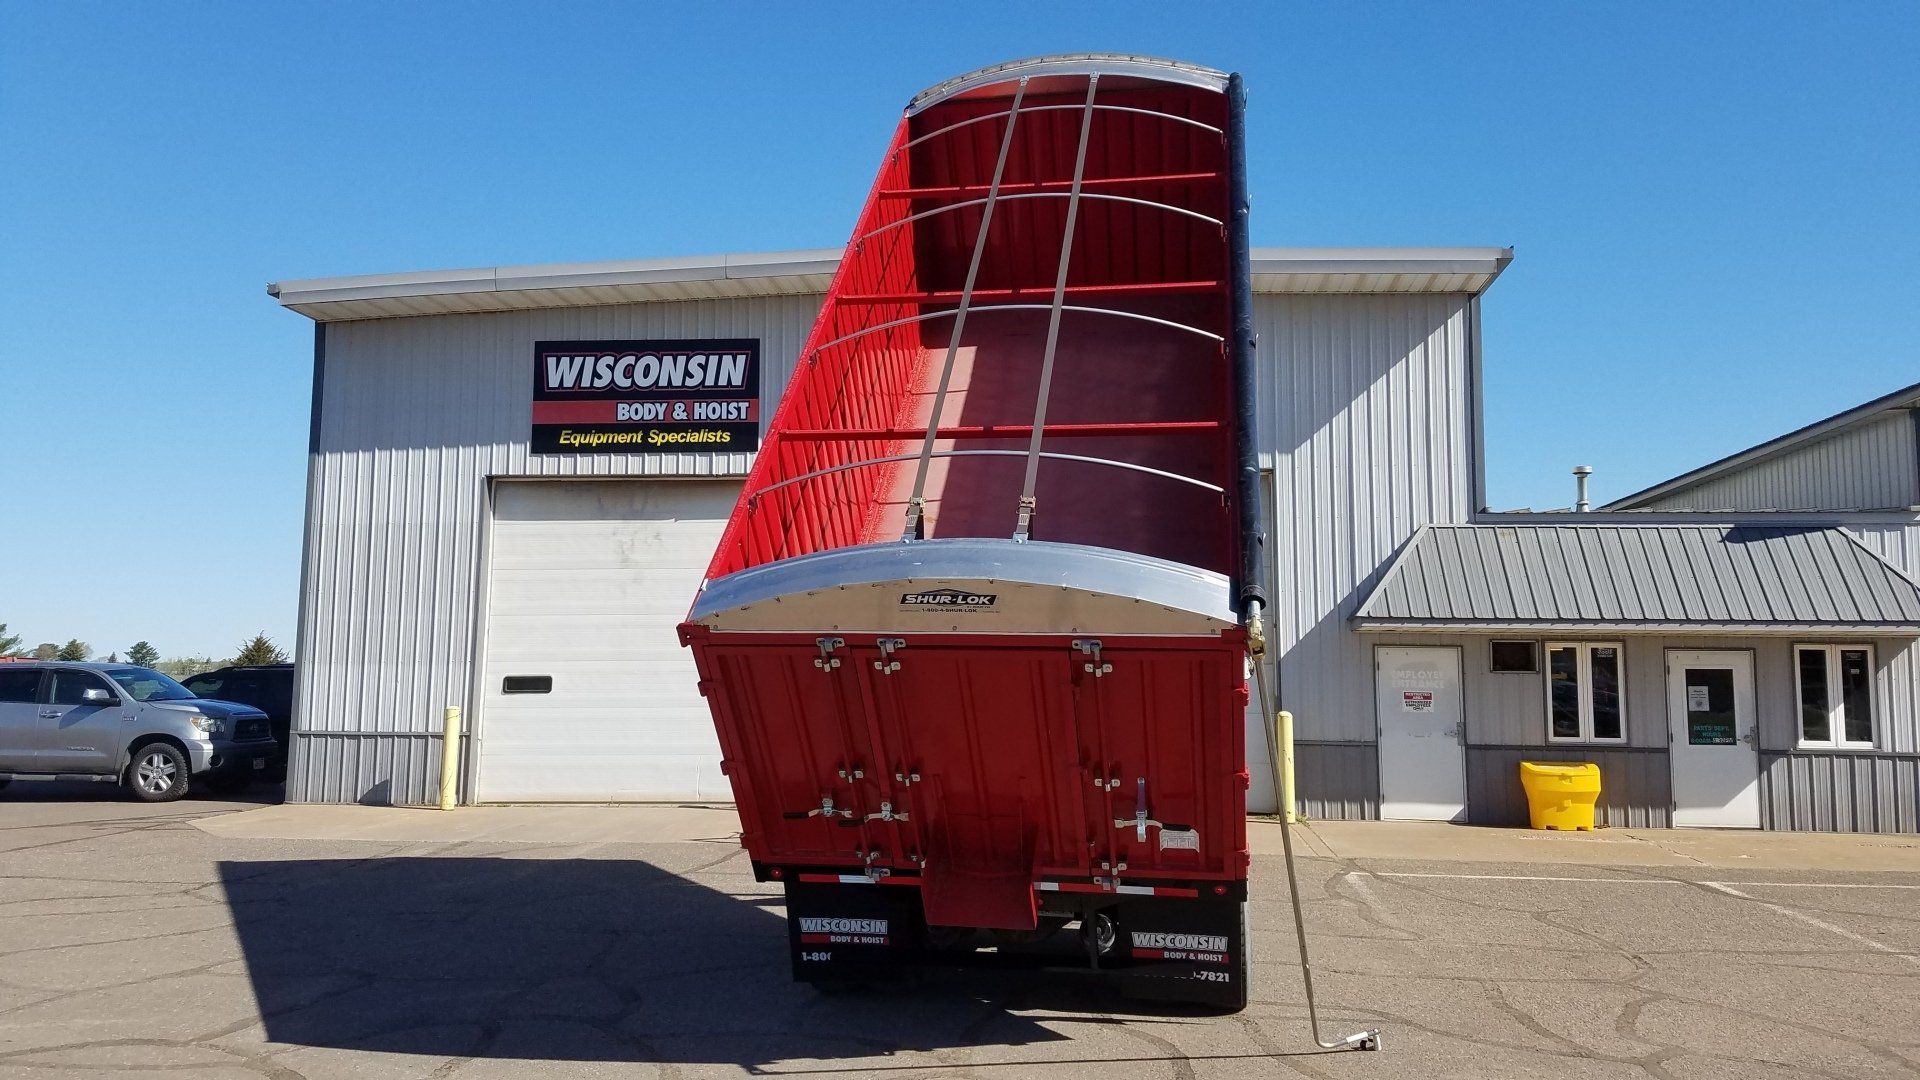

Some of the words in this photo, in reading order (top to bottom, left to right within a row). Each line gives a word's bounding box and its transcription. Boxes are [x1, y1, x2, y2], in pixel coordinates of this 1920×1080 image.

[546, 354, 748, 388] WISCONSIN
[617, 402, 667, 421] BODY
[672, 402, 688, 420] &
[693, 401, 749, 420] HOIST
[559, 430, 643, 446] Equipment
[648, 429, 731, 446] Specialists
[904, 594, 992, 605] SHUR-LOK
[800, 919, 887, 933] WISCONSIN
[861, 936, 884, 944] HOIST
[1132, 932, 1227, 950] WISCONSIN
[1164, 951, 1187, 959] BODY
[1188, 952, 1196, 960] &
[1197, 953, 1223, 962] HOIST
[1193, 971, 1230, 982] -7821
